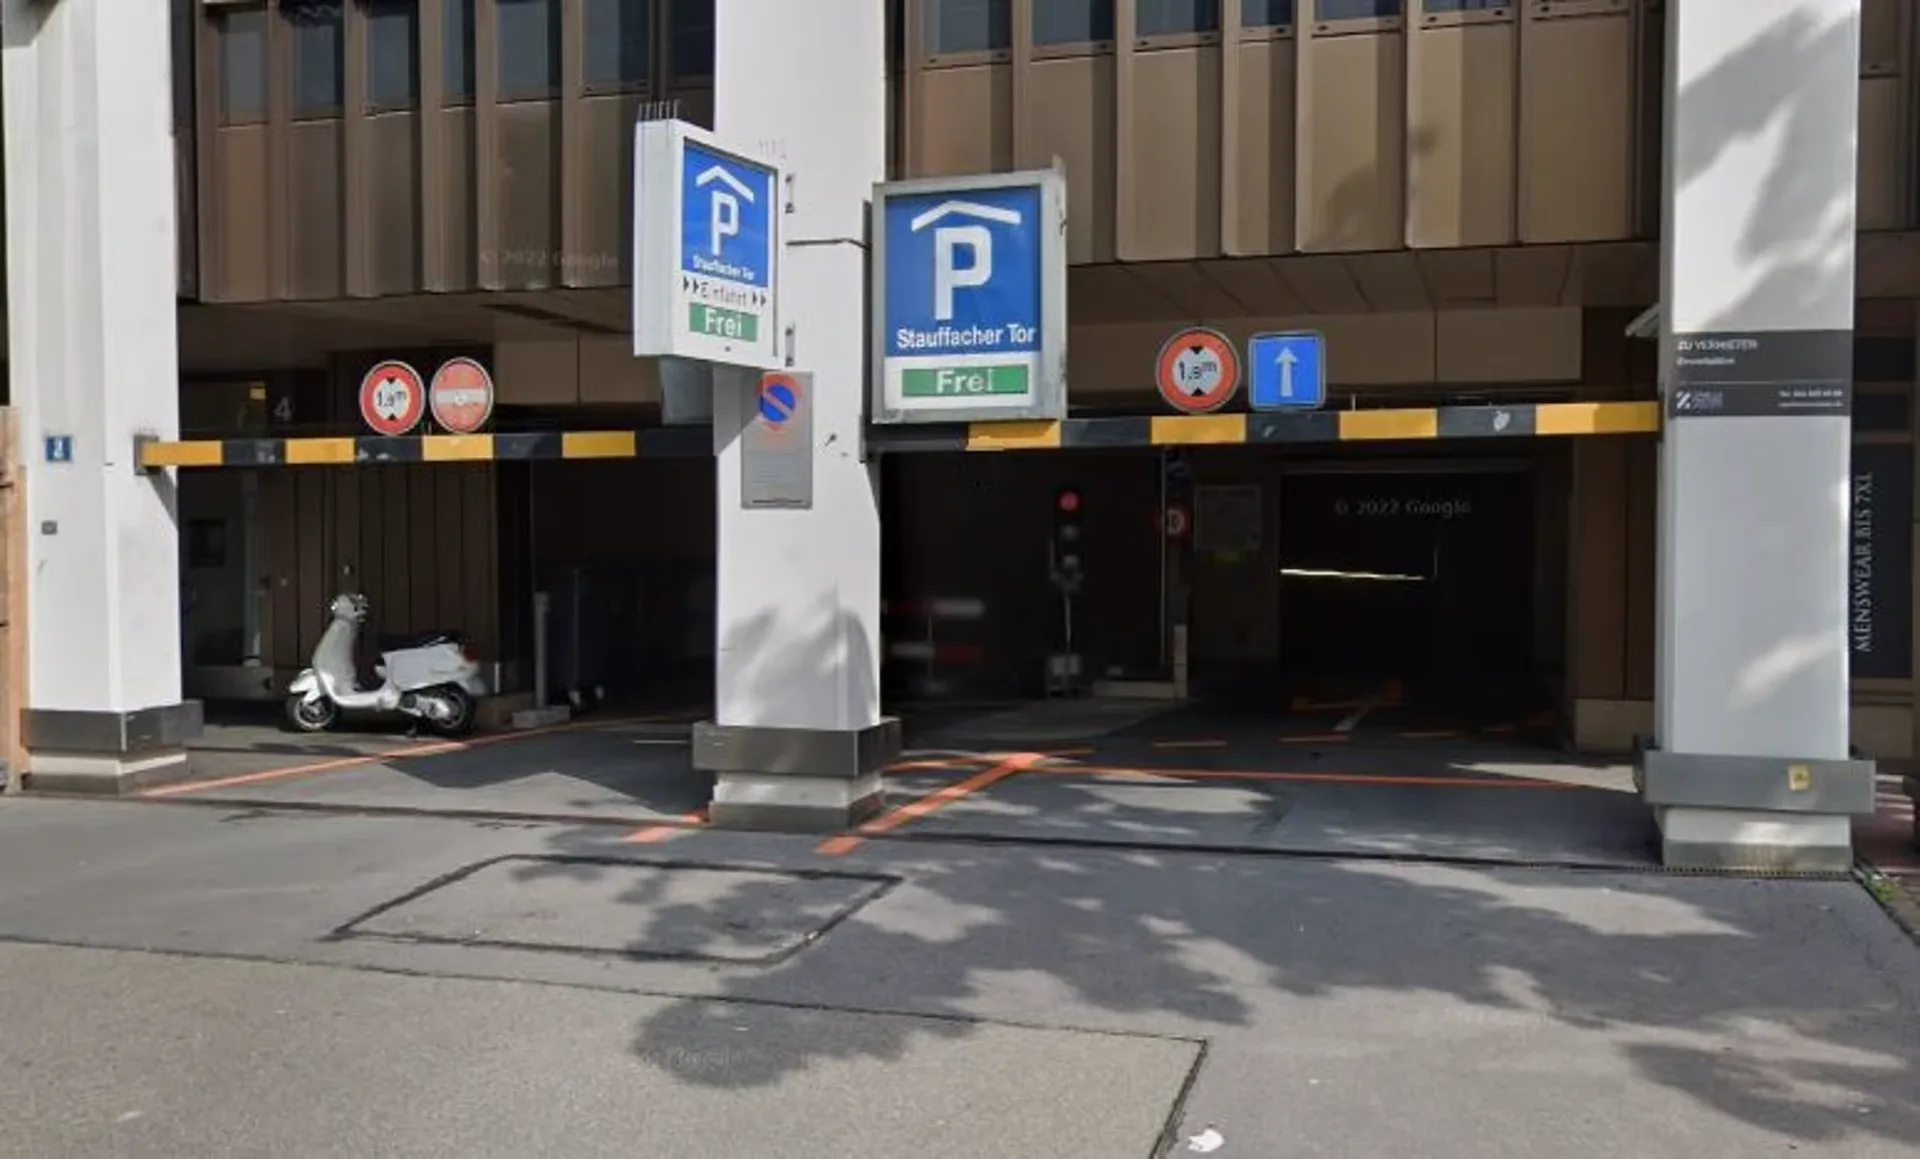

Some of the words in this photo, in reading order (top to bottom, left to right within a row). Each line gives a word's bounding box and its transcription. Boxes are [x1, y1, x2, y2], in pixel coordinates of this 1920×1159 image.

[711, 189, 739, 256] P
[935, 225, 992, 320] P
[704, 309, 742, 337] Frei
[896, 325, 1003, 349] Stauffacher
[1006, 323, 1036, 343] Tor
[936, 367, 995, 394] Frei
[273, 396, 293, 421] 4
[1854, 509, 1872, 539] BIS
[1854, 542, 1872, 652] MENSWEAR
